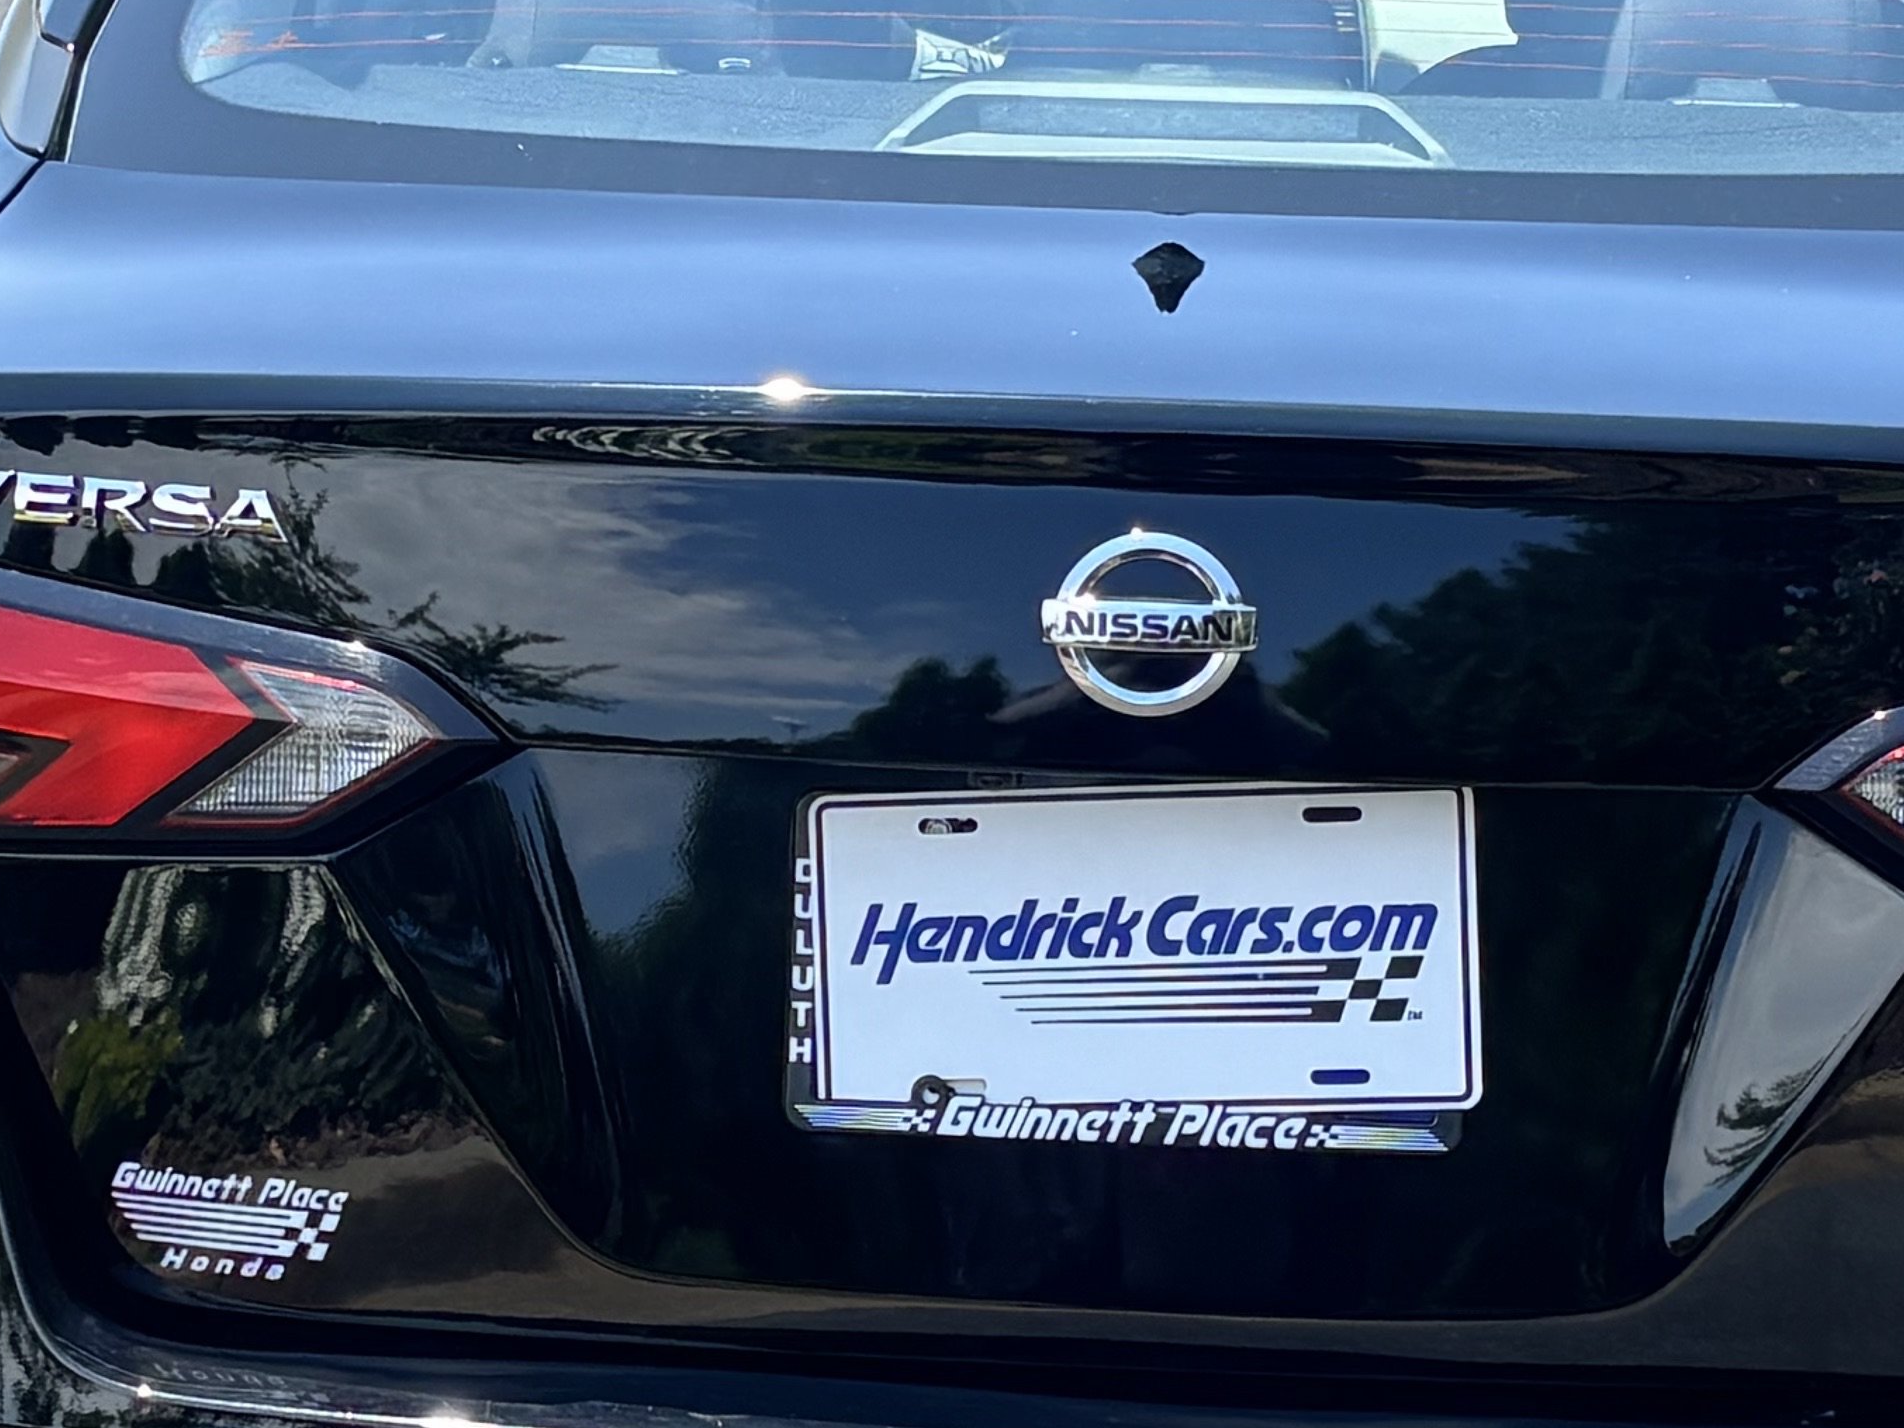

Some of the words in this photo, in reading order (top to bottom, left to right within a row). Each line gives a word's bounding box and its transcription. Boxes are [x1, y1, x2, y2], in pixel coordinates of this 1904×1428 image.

[1063, 609, 1234, 643] NISSAN
[788, 857, 815, 1064] DULUTH
[936, 1094, 1157, 1146] Gwinnett
[1163, 1103, 1307, 1151] Place
[110, 1160, 254, 1203] Gwinnett
[257, 1177, 350, 1213] Place
[159, 1246, 286, 1282] Honda
